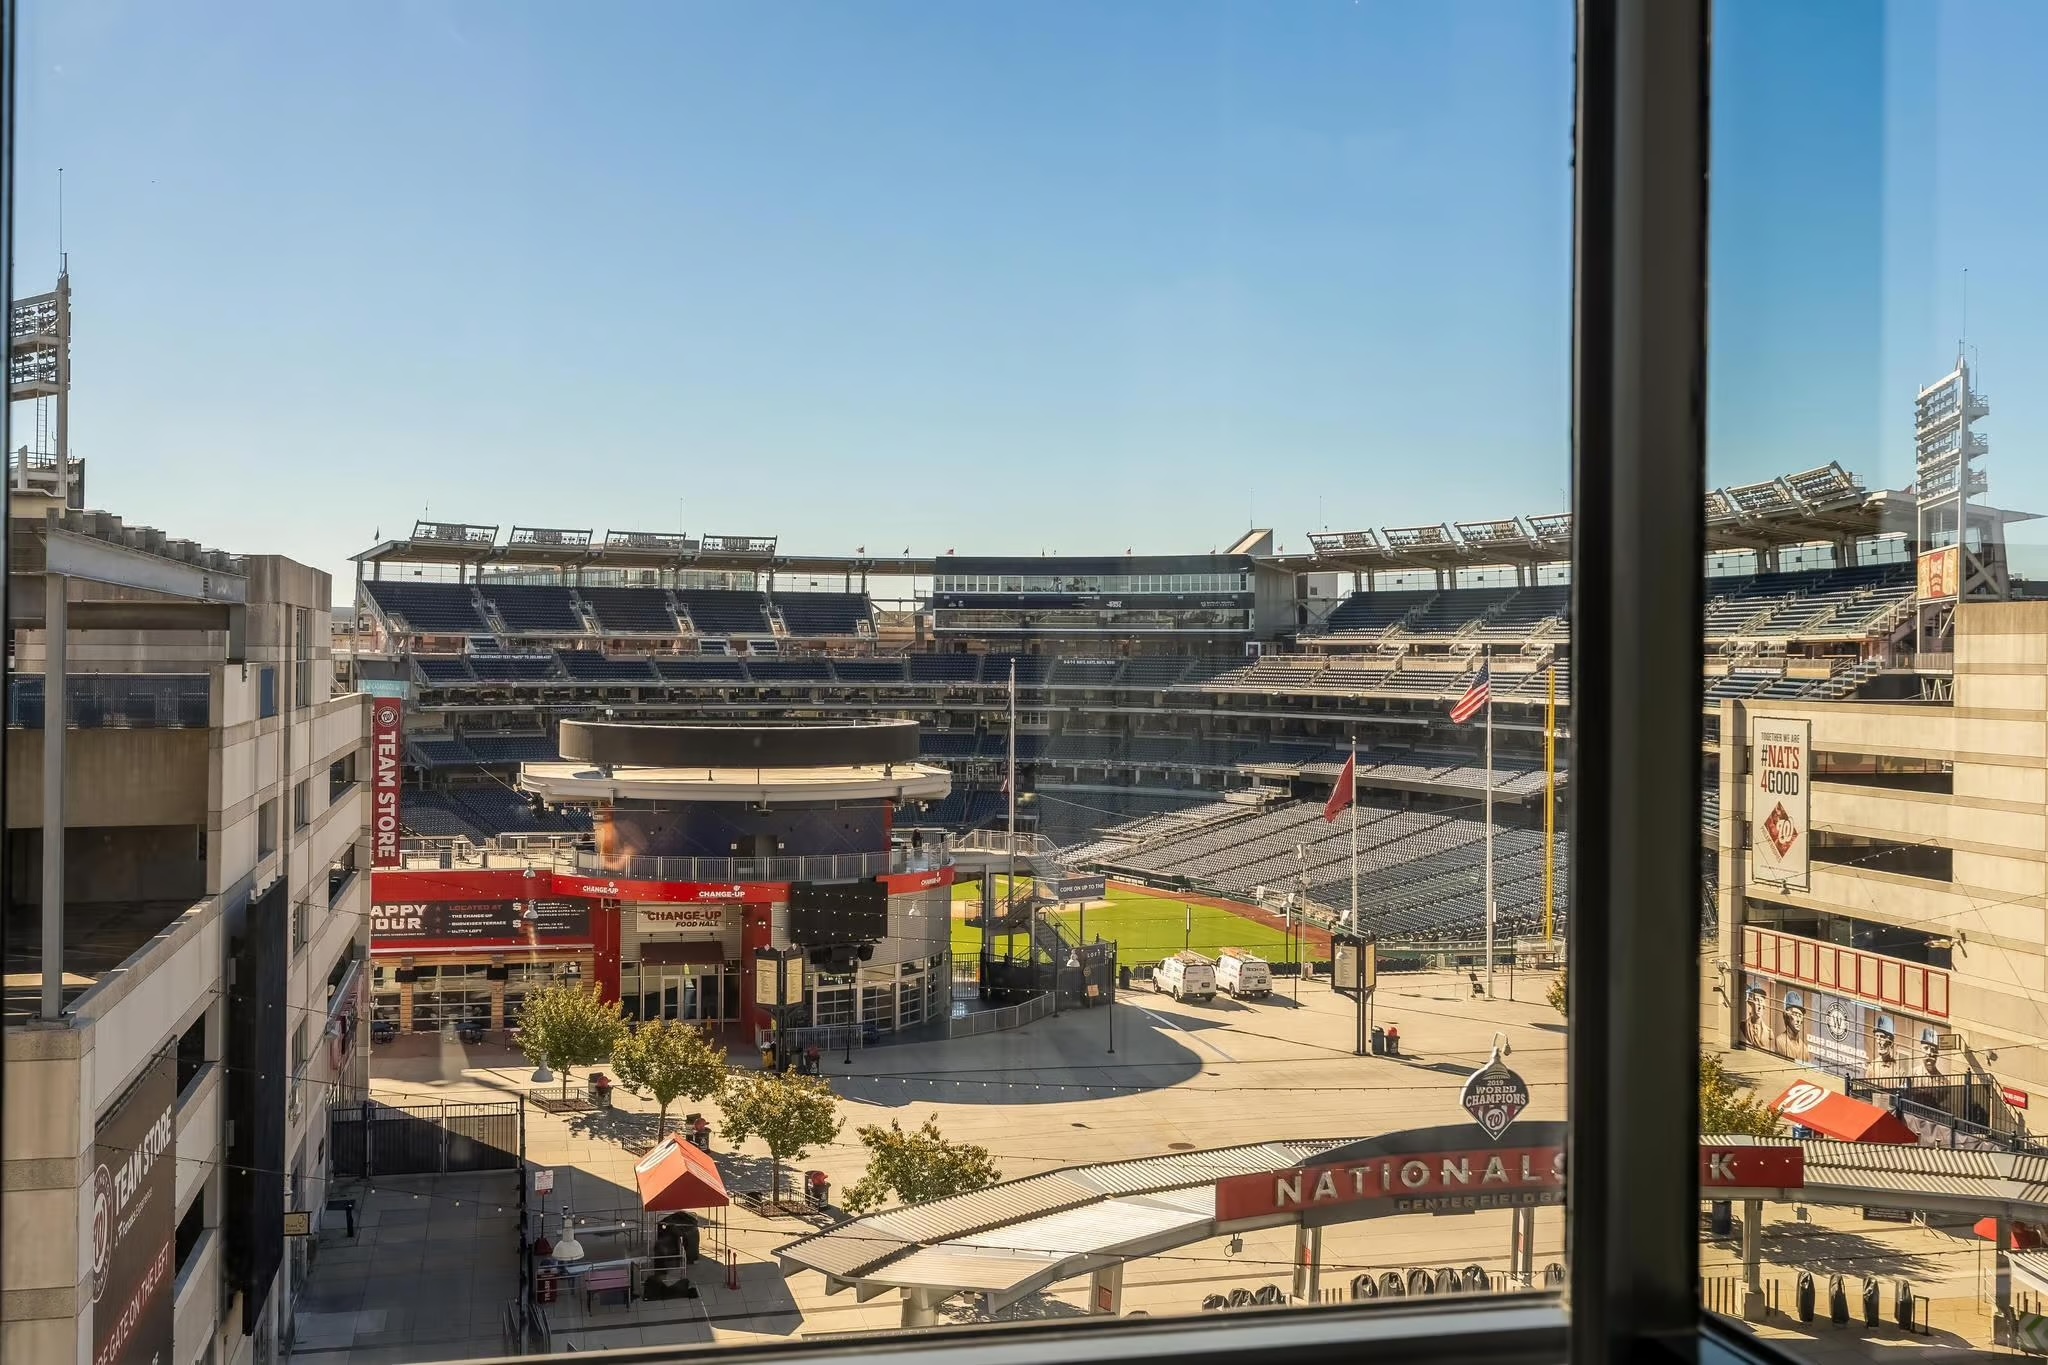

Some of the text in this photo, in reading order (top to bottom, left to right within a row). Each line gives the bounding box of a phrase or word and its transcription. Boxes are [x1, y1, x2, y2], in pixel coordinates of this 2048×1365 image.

[1761, 731, 1800, 744] TOGETHER WE ARE
[378, 731, 396, 787] TEAM
[1761, 744, 1800, 769] #NATS
[1761, 769, 1799, 796] 4GOOD
[378, 792, 396, 858] STORE
[582, 885, 619, 894] CHANGE-UP
[647, 911, 722, 921] CHANGE-UP
[1465, 1093, 1526, 1107] CHAMPIONS
[1475, 1086, 1517, 1094] WORLD
[115, 1104, 172, 1216] TEAM STORE
[1401, 1196, 1475, 1211] CENTER
[1480, 1191, 1536, 1205] FIELD
[110, 1241, 169, 1362] GATE ON THE LEFT
